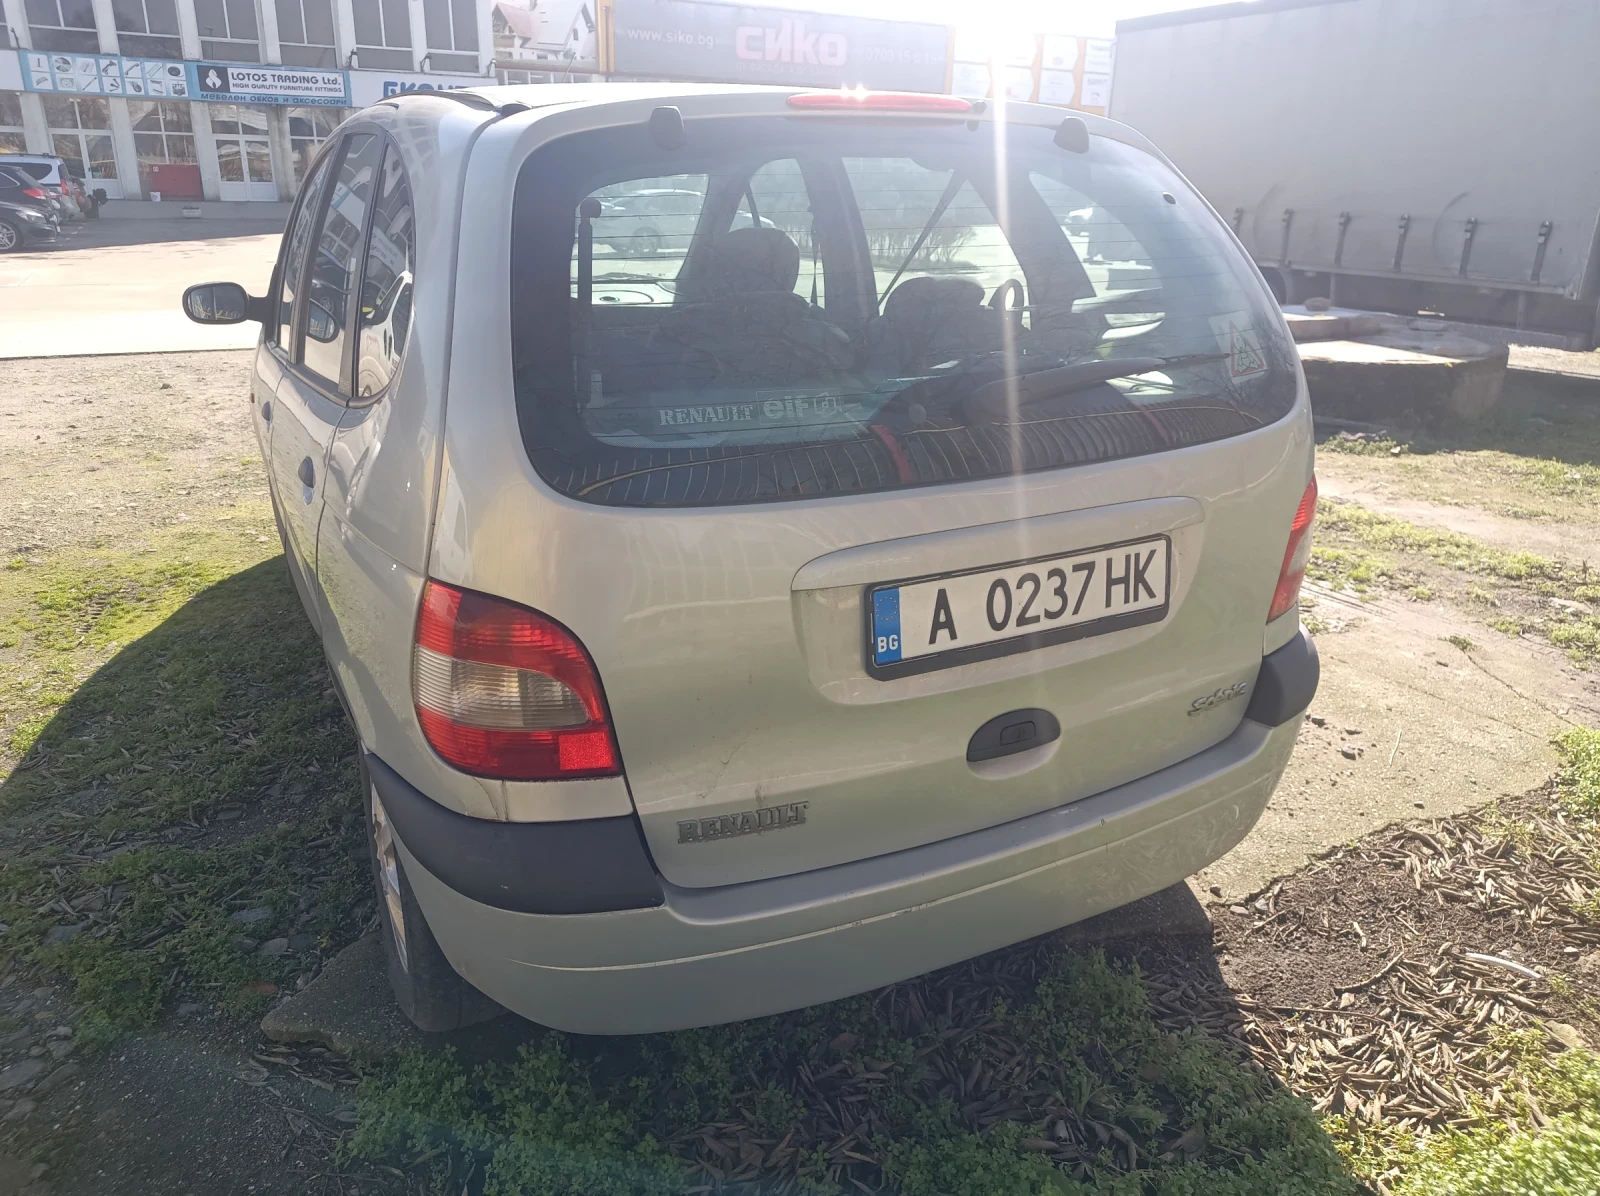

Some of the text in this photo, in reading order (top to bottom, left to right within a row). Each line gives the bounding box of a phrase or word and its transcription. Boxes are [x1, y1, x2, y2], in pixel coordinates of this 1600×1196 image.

[627, 28, 714, 49] www.siko.bg
[231, 71, 342, 86] LOTOS TRADING Ltd.
[251, 83, 279, 91] QUALITY
[658, 404, 754, 426] RENAULT
[928, 548, 1158, 645] A 0237 HK
[877, 634, 900, 654] BG
[677, 800, 810, 845] RENAULT
